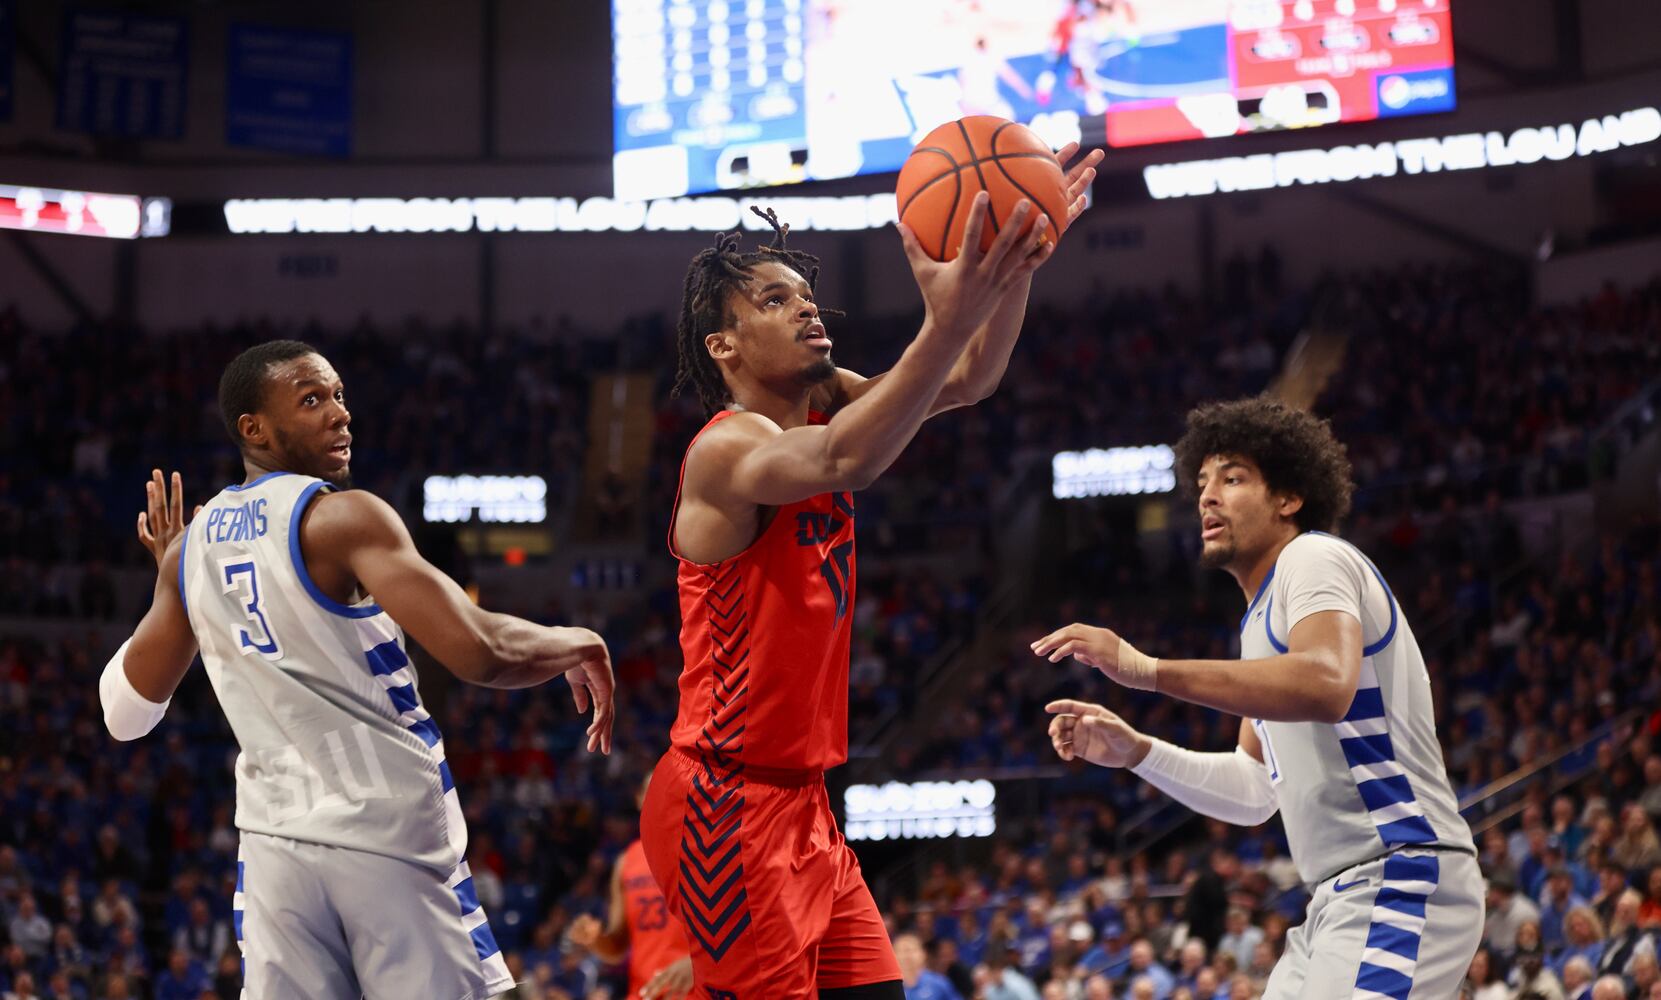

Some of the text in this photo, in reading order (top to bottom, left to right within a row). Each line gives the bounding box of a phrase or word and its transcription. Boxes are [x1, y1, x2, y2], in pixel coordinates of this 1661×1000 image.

[1275, 143, 1397, 186] FROM
[1397, 132, 1486, 174] THE
[1486, 124, 1577, 167] LOU
[1577, 106, 1661, 156] AND
[219, 555, 283, 660] 3
[637, 896, 667, 930] 23
